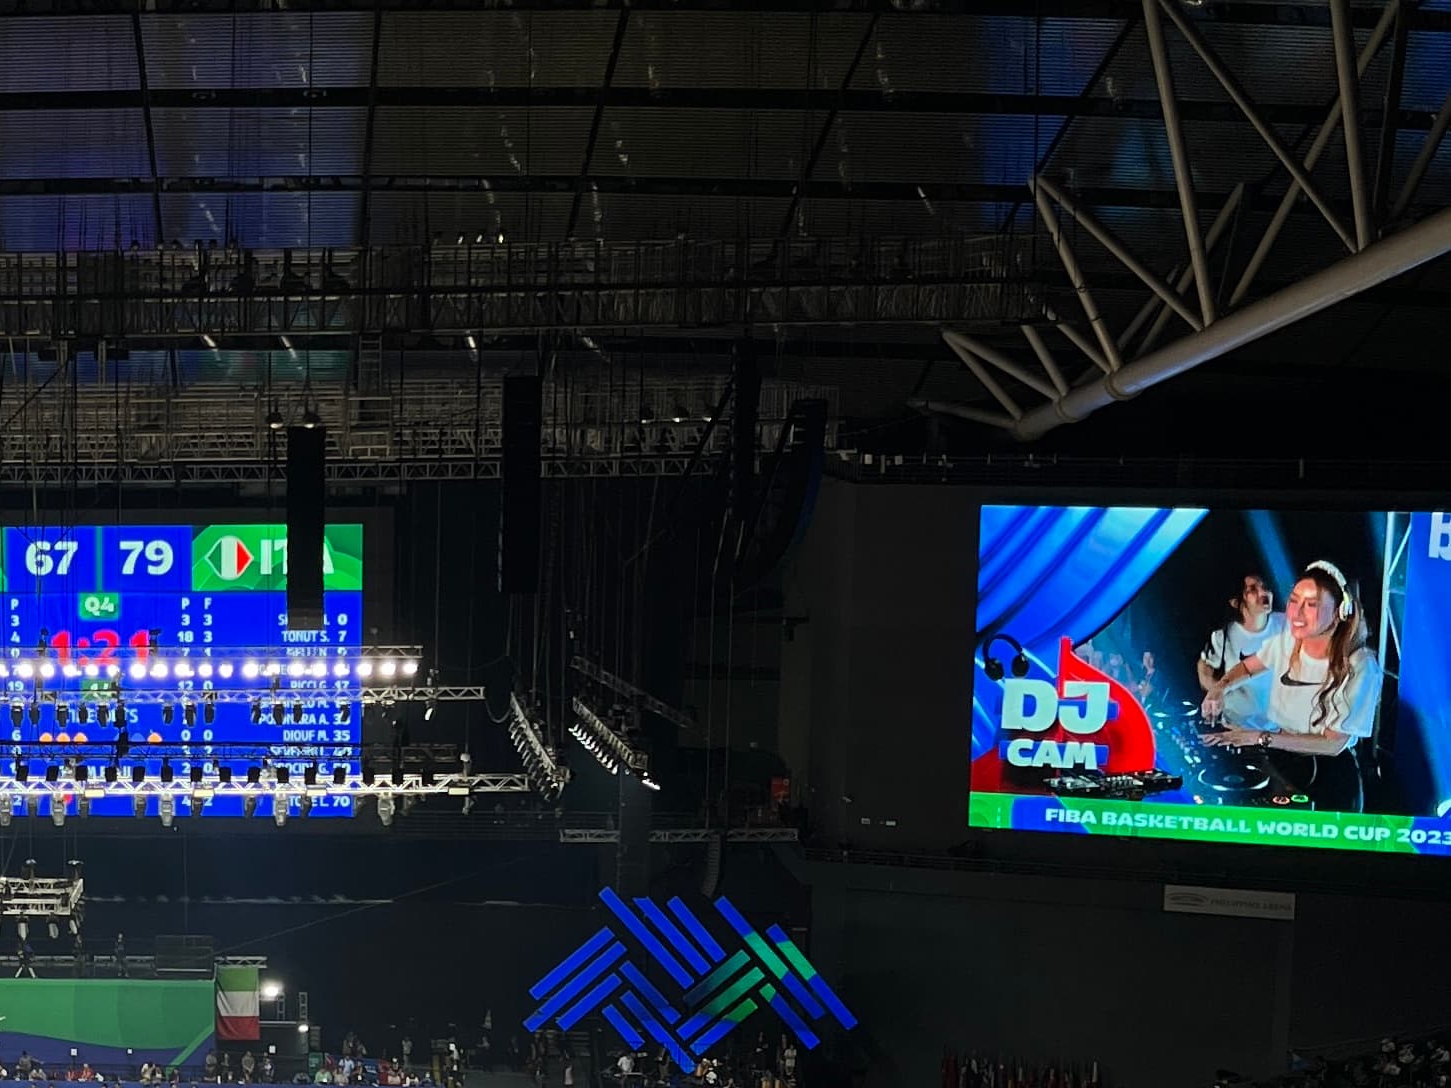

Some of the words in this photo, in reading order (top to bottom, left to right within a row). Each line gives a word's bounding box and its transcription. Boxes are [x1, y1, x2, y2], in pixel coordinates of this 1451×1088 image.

[25, 541, 78, 576] 67
[119, 540, 173, 575] 79
[11, 599, 19, 611] P
[85, 597, 115, 616] Q4
[182, 598, 190, 610] P
[204, 598, 212, 610] F
[11, 615, 20, 627] 3
[181, 614, 190, 626] 3
[203, 614, 212, 626] 3
[338, 614, 348, 626] 0
[11, 632, 20, 643] 4
[177, 631, 194, 643] 18
[203, 631, 212, 643] 3
[281, 631, 317, 643] TONUT
[338, 631, 347, 643] 7
[51, 630, 150, 666] 1:21
[1002, 679, 1110, 734] DJ
[12, 730, 21, 741] 6
[181, 730, 191, 741] 0
[203, 730, 213, 741] 0
[283, 730, 315, 741] DIOUF
[333, 730, 350, 741] 35
[1007, 739, 1097, 770] CAM
[333, 796, 350, 807] 70
[1045, 808, 1097, 824] FIBA
[1101, 811, 1251, 833] BASKETBALL
[1256, 820, 1338, 839] WORLD
[1344, 825, 1390, 842] CUP
[1396, 829, 1451, 846] 2023
